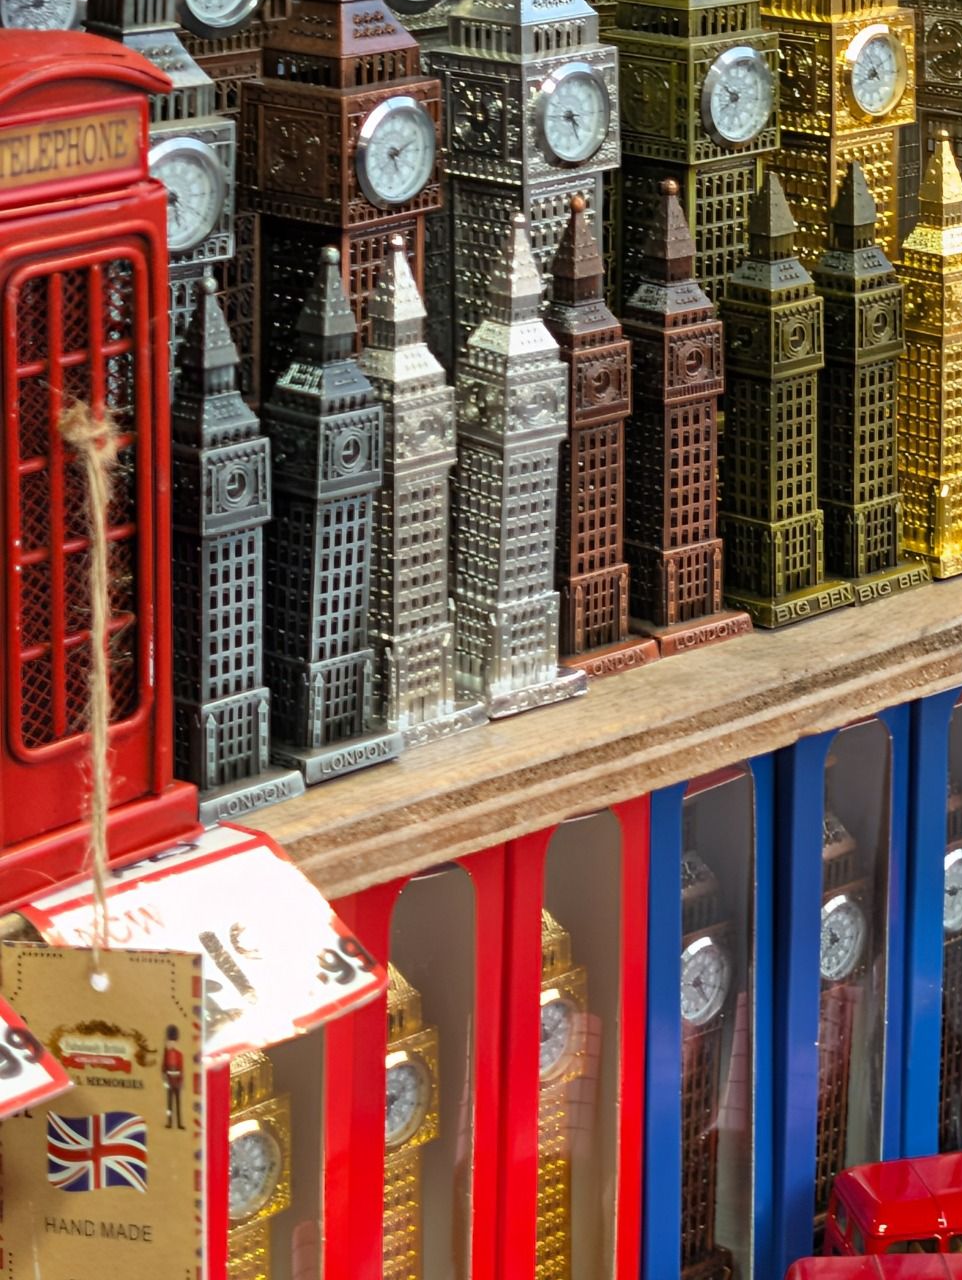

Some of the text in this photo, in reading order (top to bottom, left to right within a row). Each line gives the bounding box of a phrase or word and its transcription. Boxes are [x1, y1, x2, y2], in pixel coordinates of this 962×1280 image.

[857, 566, 930, 603] BIG BEN
[775, 585, 853, 623] BIG BEN
[674, 620, 739, 650] LONDON
[320, 739, 391, 775] LONDON
[217, 781, 291, 818] LONDON
[44, 1217, 153, 1242] HAND MADE
